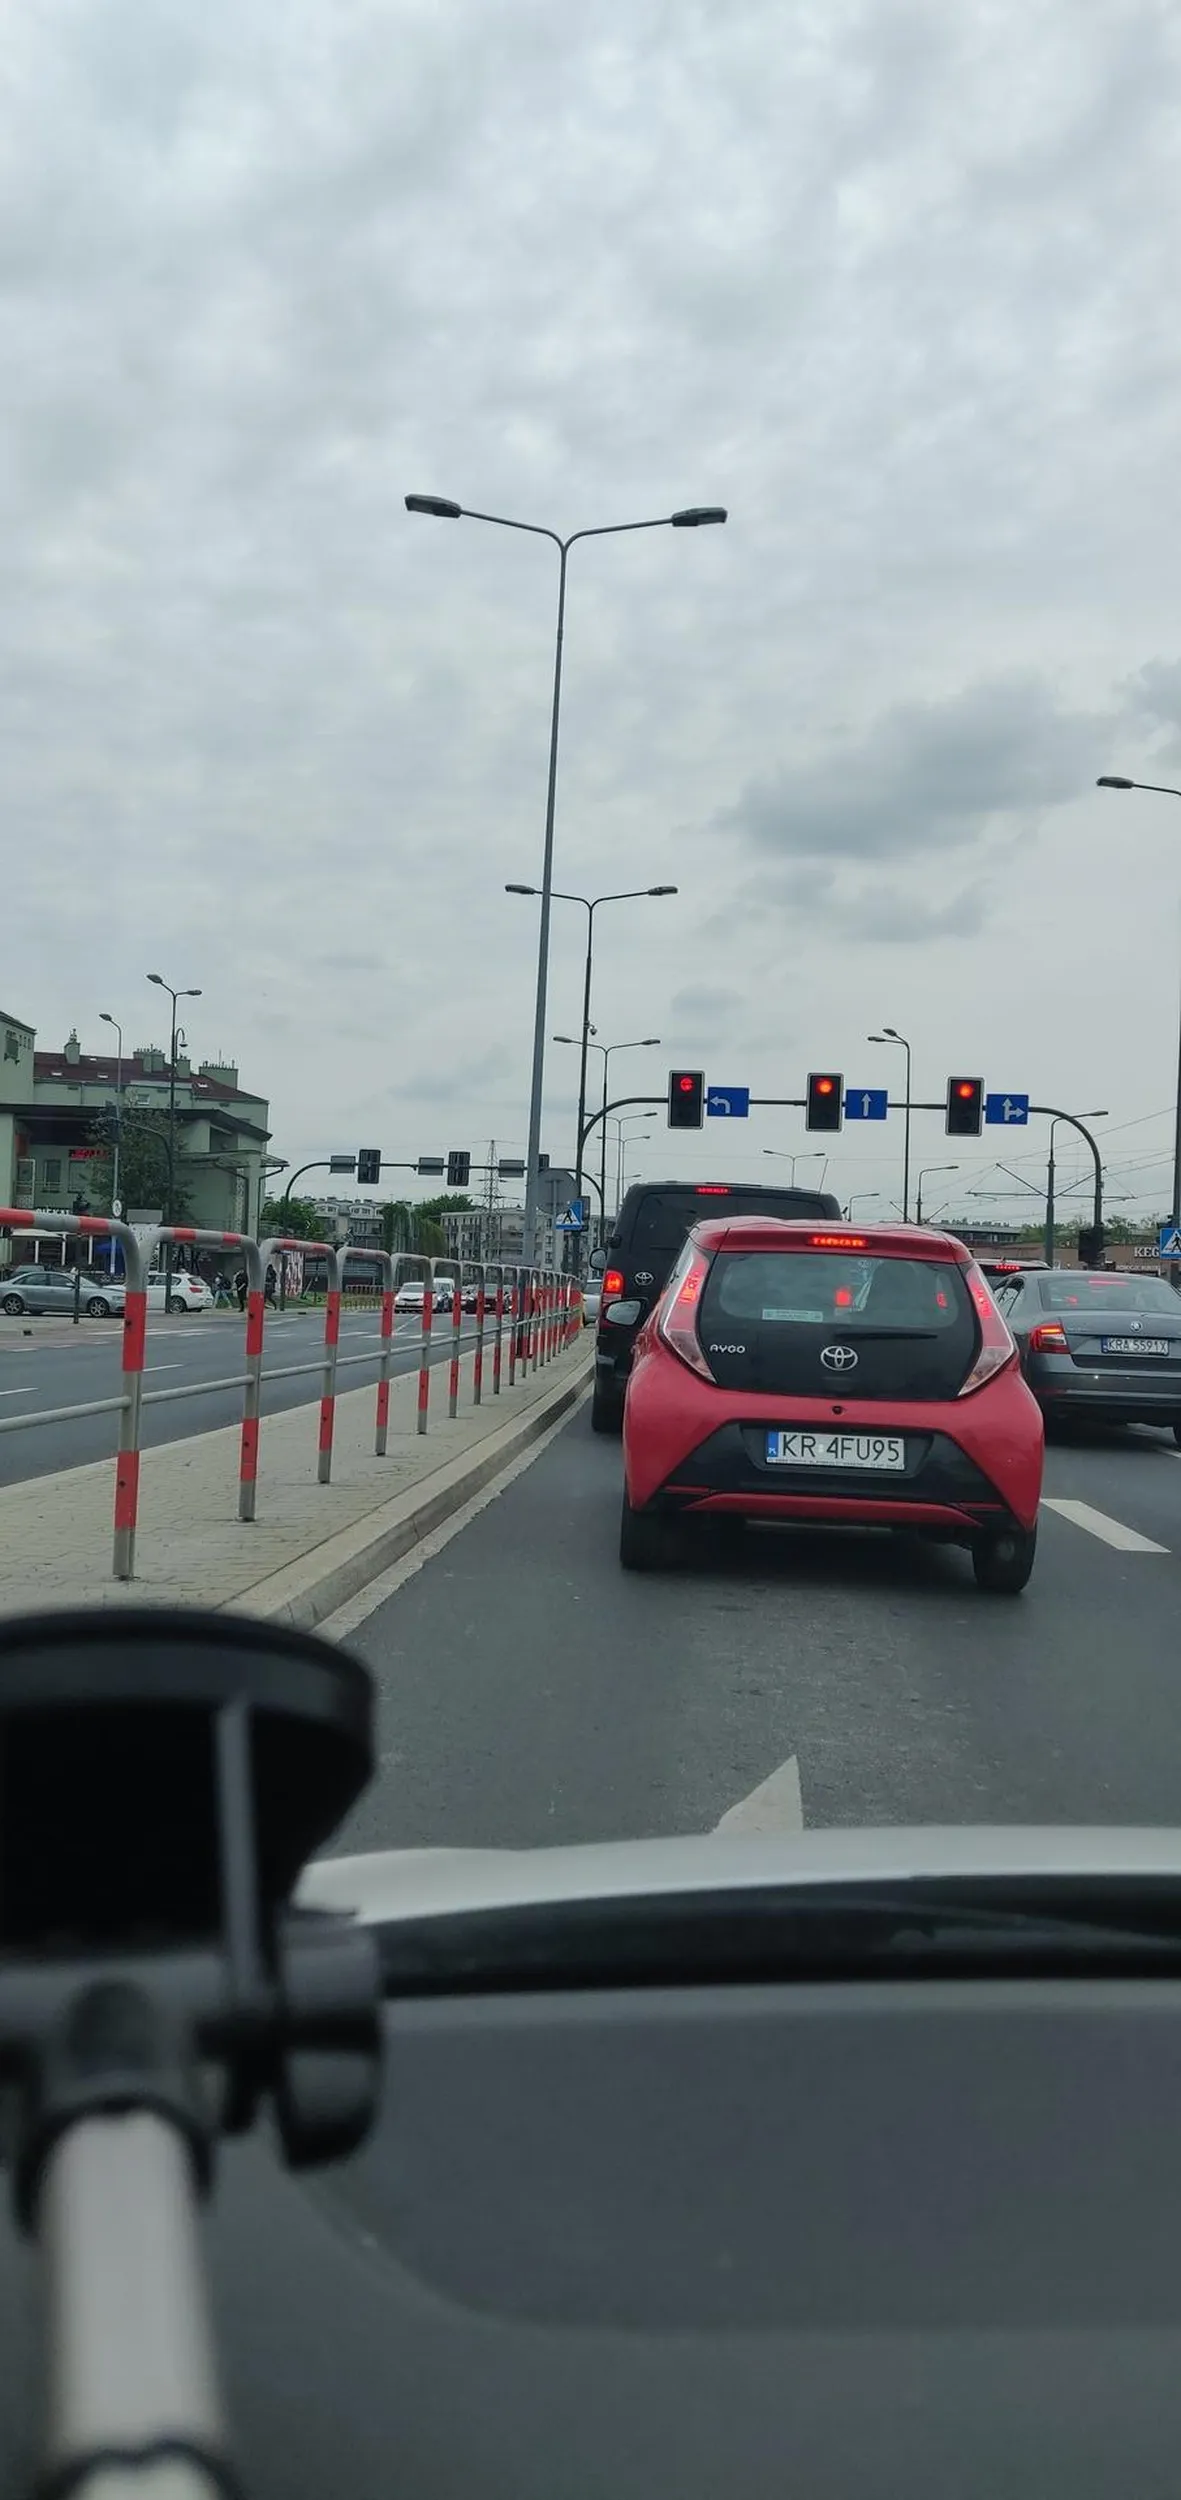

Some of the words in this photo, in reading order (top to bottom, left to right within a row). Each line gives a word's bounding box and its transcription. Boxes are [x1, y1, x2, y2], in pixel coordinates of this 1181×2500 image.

[1134, 1247, 1159, 1258] KEG
[709, 1344, 746, 1354] AYGO
[1108, 1338, 1129, 1351] KRA
[1132, 1339, 1167, 1353] 5591X
[782, 1434, 816, 1458] KR
[826, 1437, 900, 1462] 4FU95
